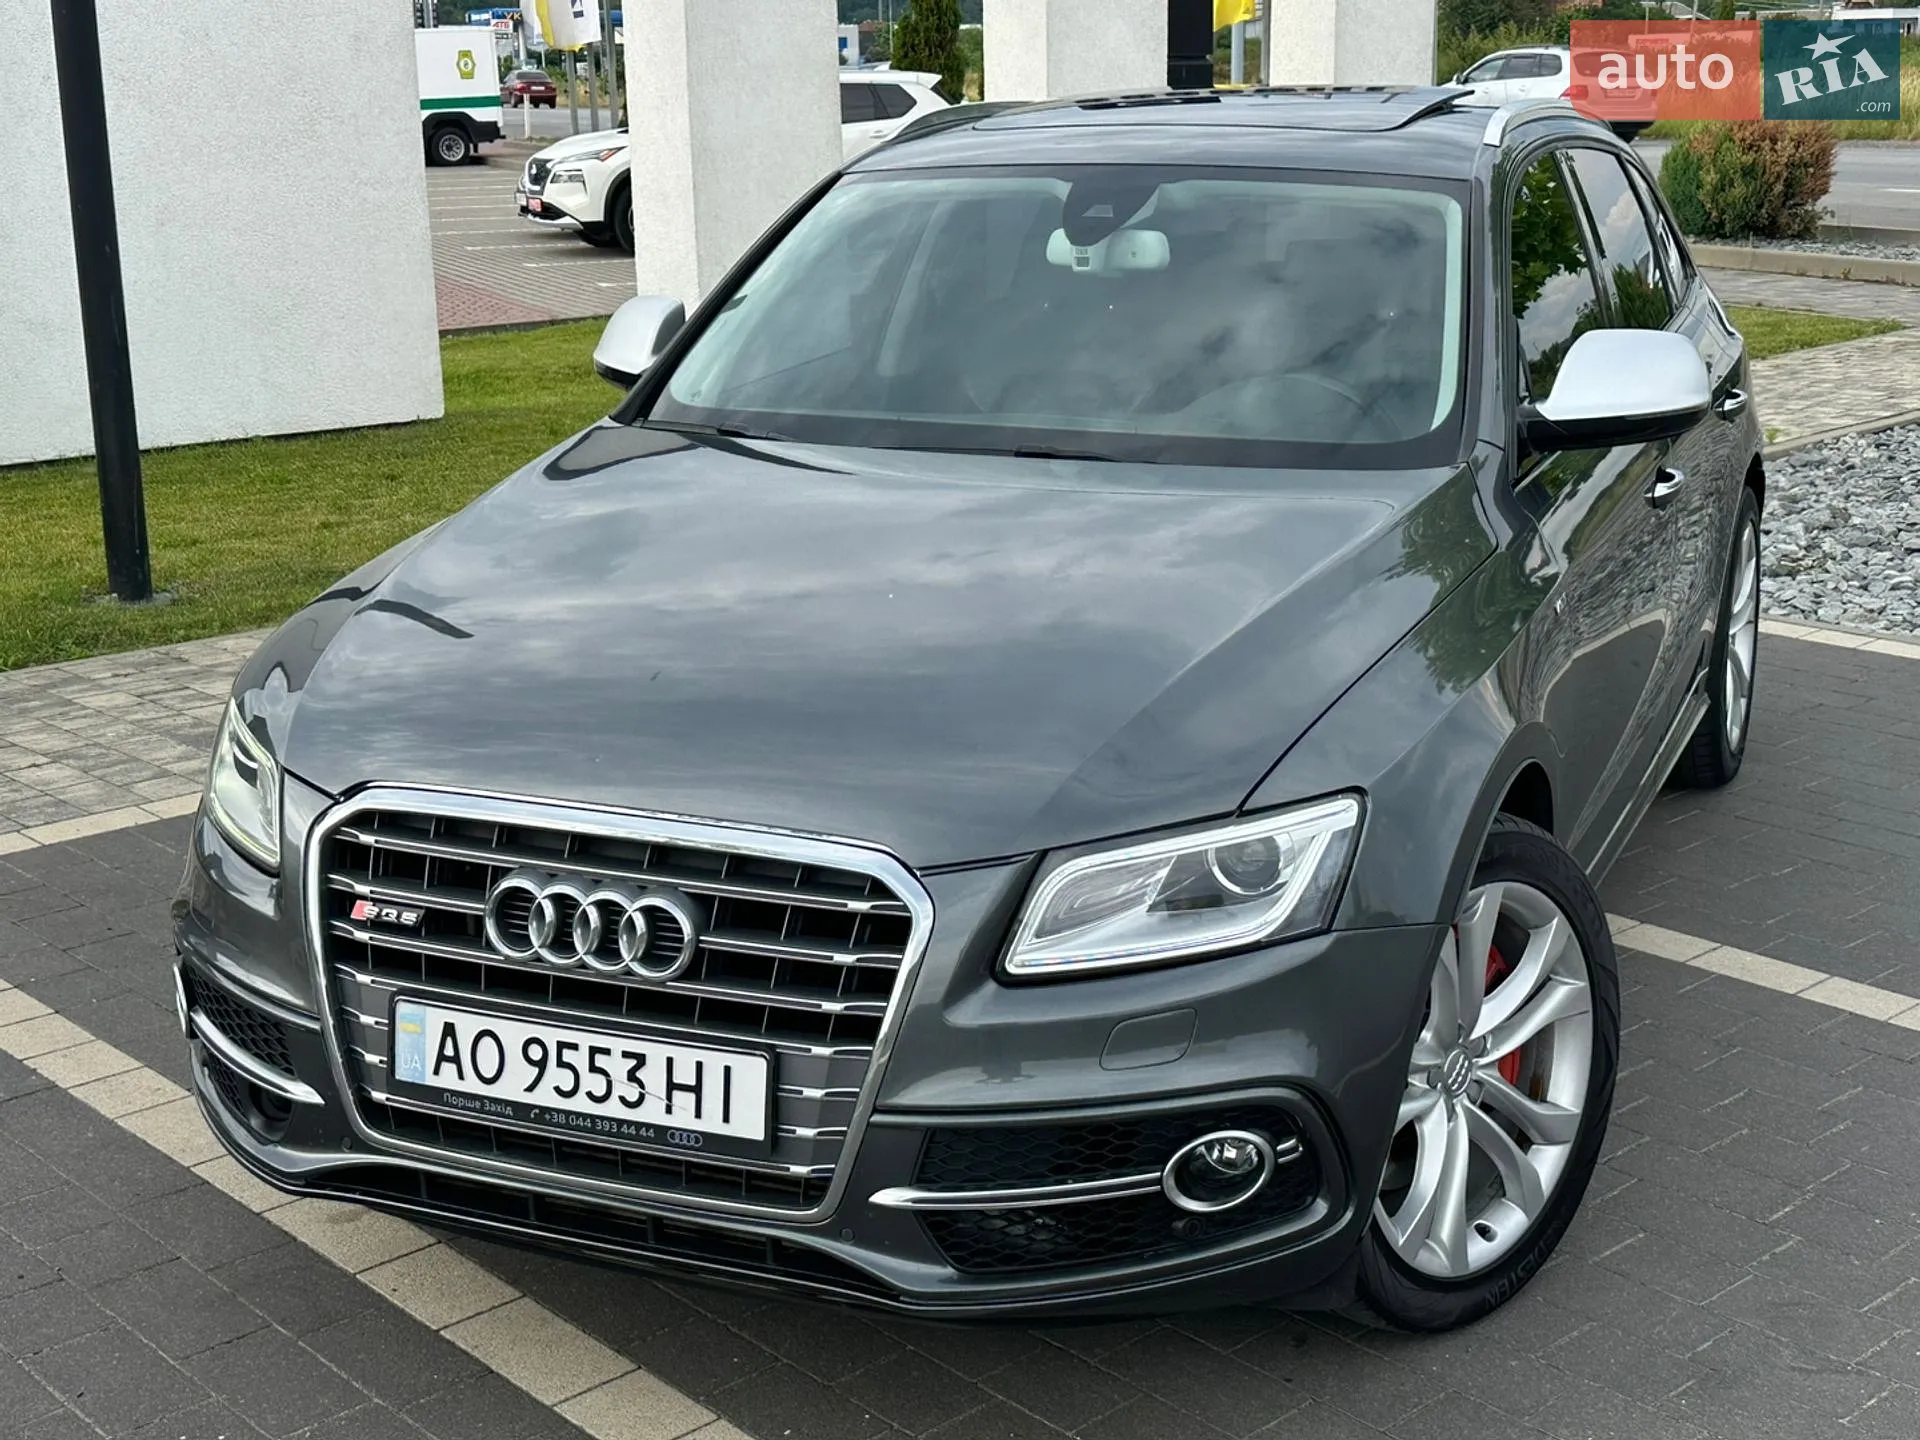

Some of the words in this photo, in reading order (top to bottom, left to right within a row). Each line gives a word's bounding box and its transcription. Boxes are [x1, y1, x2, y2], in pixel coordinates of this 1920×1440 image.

[400, 1050, 422, 1072] UA
[433, 1021, 505, 1086] AO
[521, 1036, 647, 1110] 9553
[665, 1056, 731, 1124] HI
[443, 1093, 481, 1109] Порше
[482, 1100, 513, 1117] Захід
[544, 1111, 566, 1124] +38
[569, 1115, 592, 1128] 044
[595, 1118, 617, 1132] 393
[621, 1123, 637, 1135] 44
[639, 1125, 655, 1138] 44
